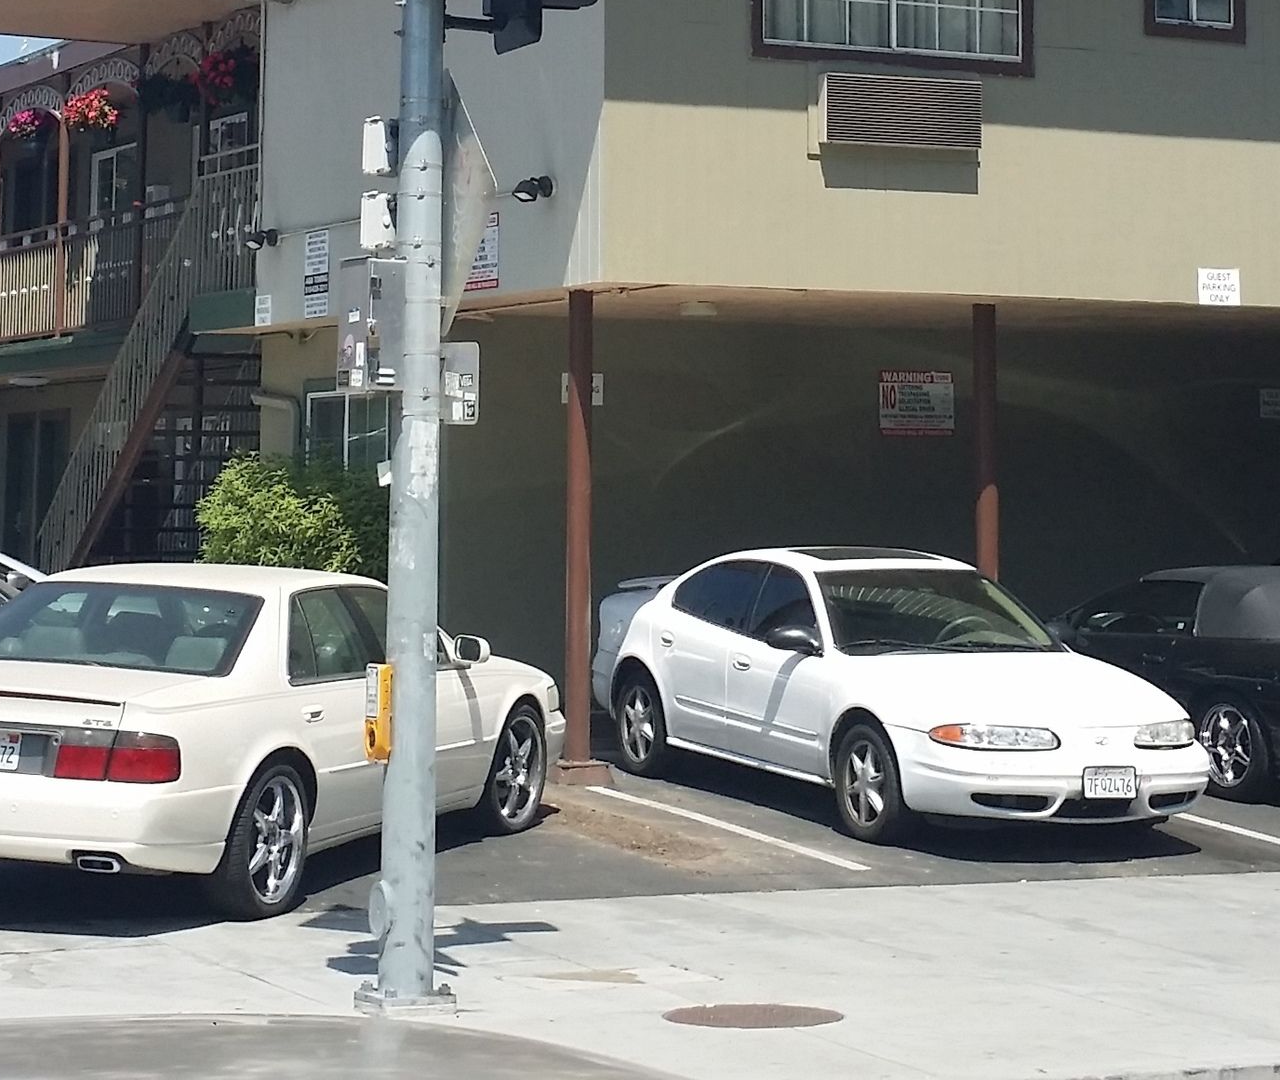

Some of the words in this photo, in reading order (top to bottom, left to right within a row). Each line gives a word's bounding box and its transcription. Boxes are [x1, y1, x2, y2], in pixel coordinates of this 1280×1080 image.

[1206, 272, 1231, 281] GUEST
[1202, 283, 1237, 292] PARKING
[1210, 294, 1231, 302] ONLY
[881, 371, 932, 383] WARNING
[881, 384, 897, 410] NO
